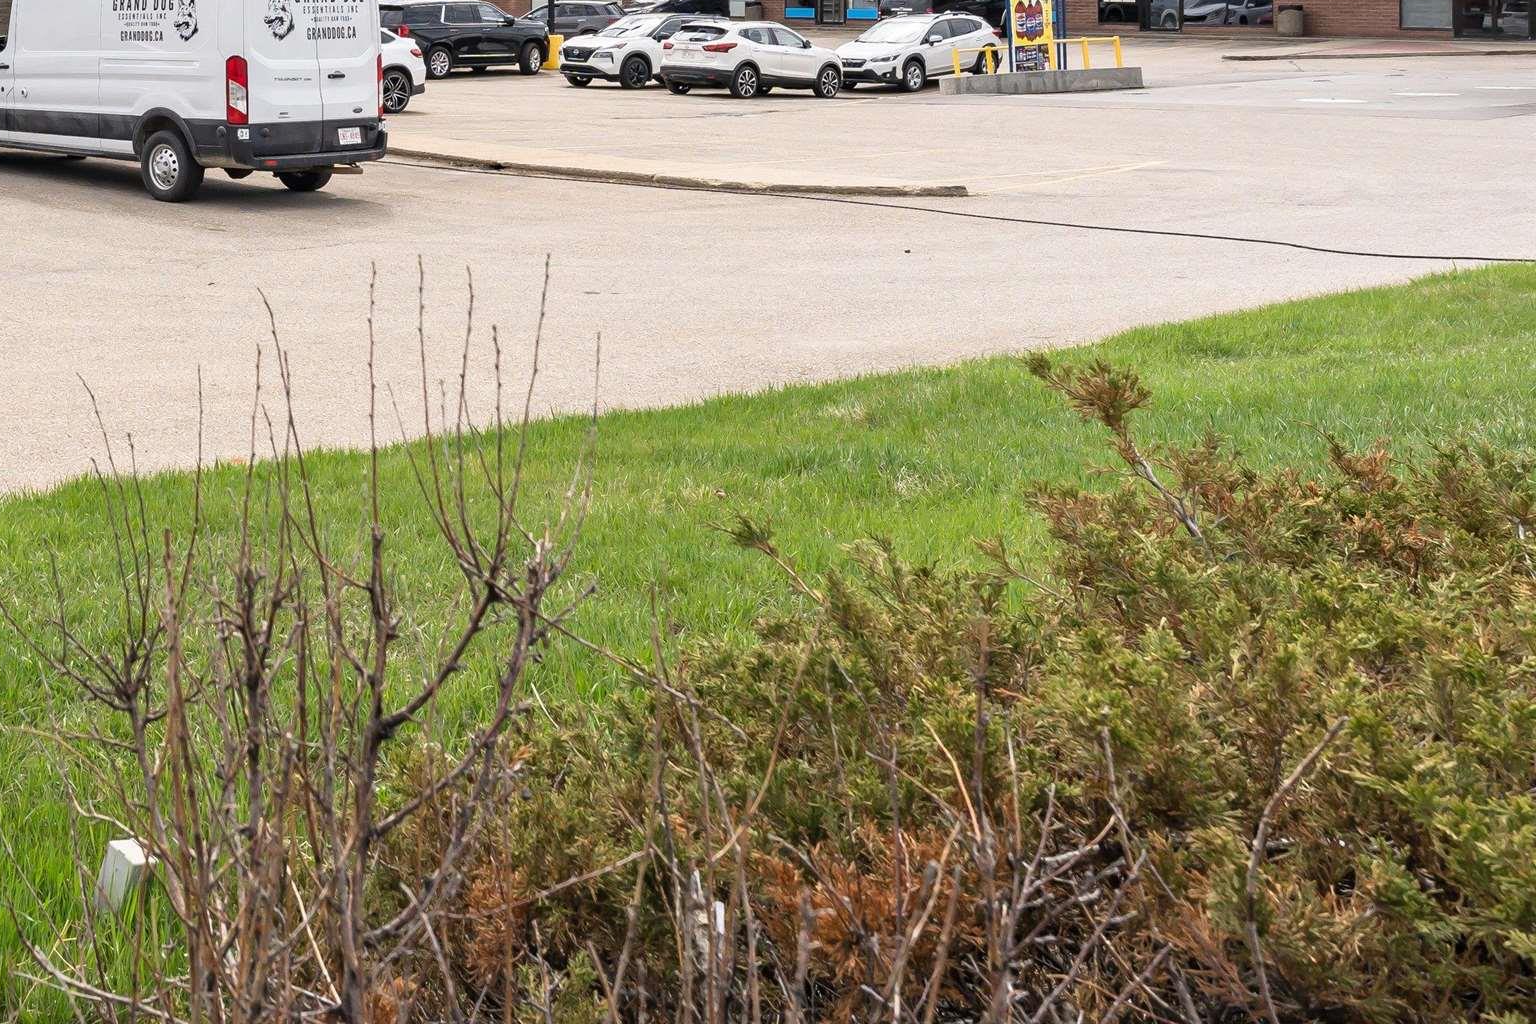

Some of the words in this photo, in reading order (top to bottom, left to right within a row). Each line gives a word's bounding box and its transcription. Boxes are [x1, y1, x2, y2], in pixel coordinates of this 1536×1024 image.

[303, 5, 344, 14] ESSENTIALS
[347, 5, 358, 13] INC
[120, 31, 164, 42] GRANDDOG.CA
[306, 26, 357, 40] GRANDDOG.CA
